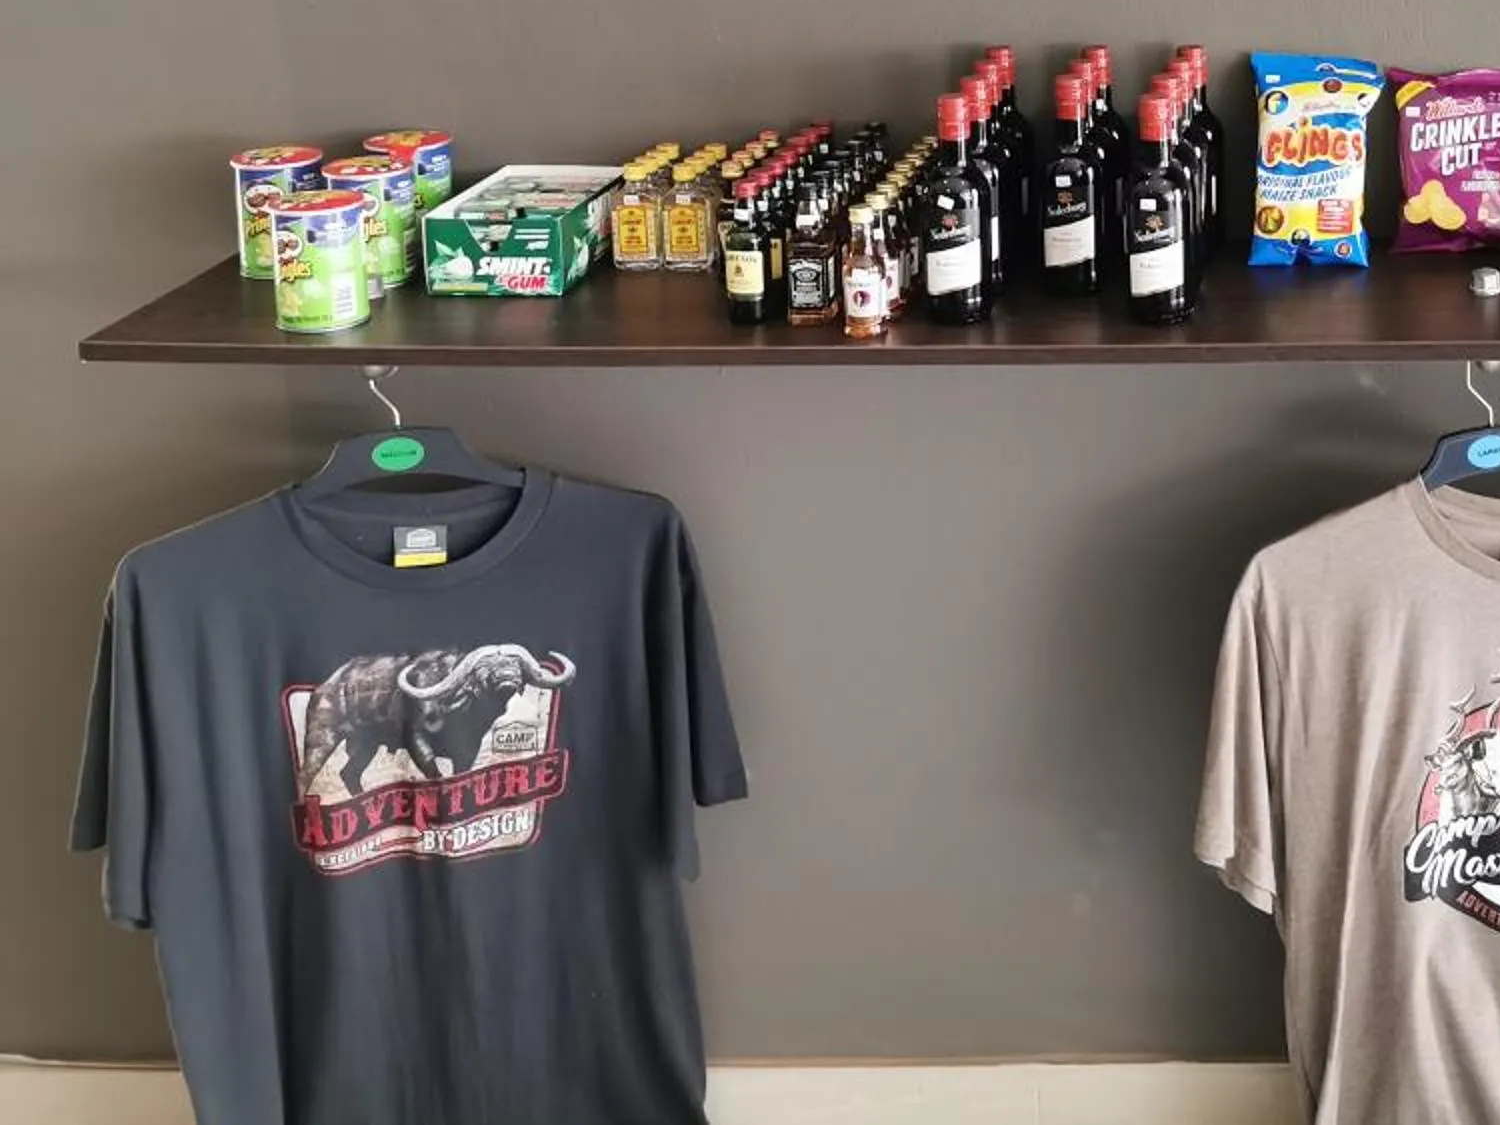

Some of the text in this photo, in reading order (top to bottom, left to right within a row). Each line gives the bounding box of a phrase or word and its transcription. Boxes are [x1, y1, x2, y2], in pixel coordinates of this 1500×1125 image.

[1264, 117, 1364, 165] FLINGS
[1440, 141, 1483, 176] CUT
[1298, 186, 1338, 201] SNACK
[506, 276, 547, 290] GUM
[302, 756, 560, 846] ADVENTURE
[422, 808, 530, 852] BY DESIGN
